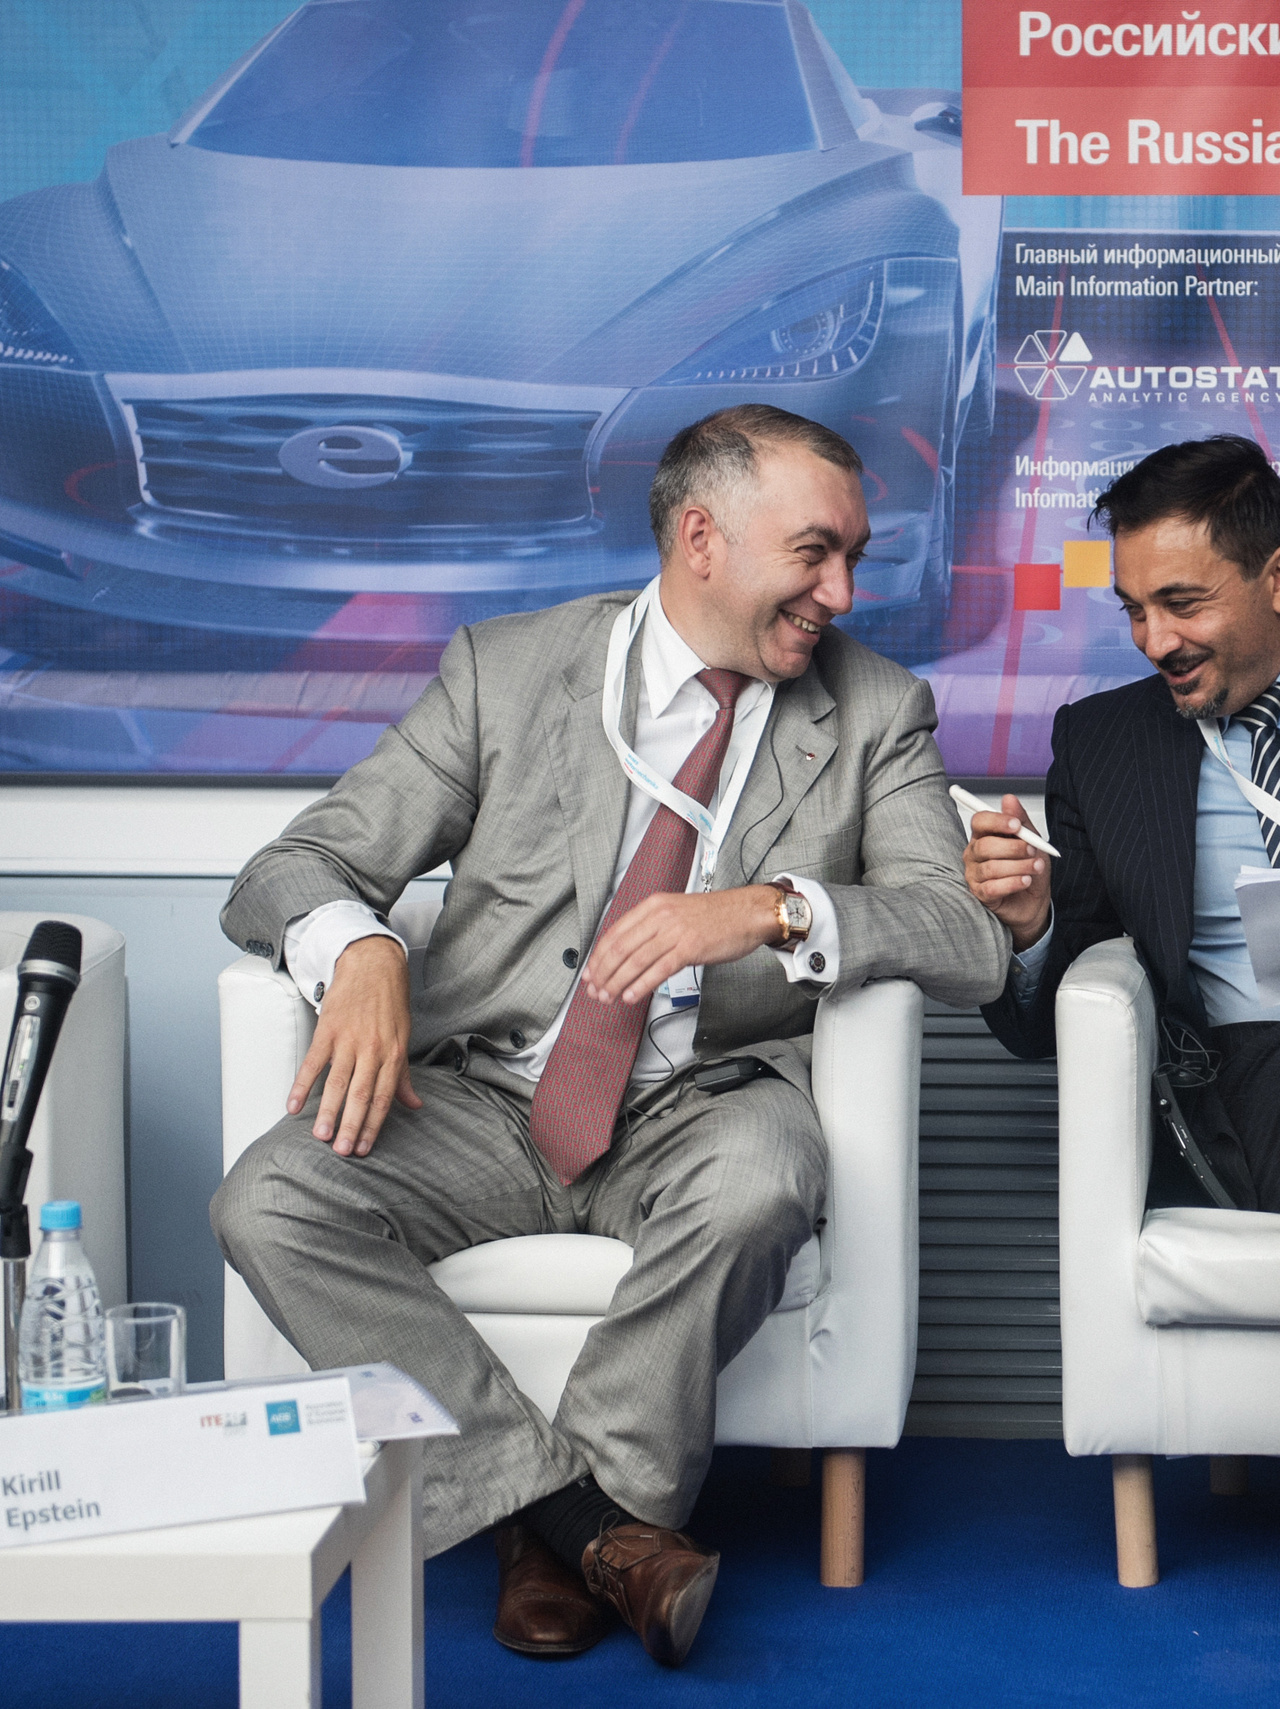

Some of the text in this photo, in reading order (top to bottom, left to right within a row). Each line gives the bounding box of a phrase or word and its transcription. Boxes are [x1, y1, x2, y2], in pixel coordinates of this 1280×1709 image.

[1015, 119, 1112, 166] The
[1015, 244, 1099, 266] Главный
[1015, 275, 1260, 297] Main Information Partner:
[1088, 392, 1189, 404] ANALYTIC
[2, 1470, 61, 1496] Kirill
[6, 1499, 101, 1531] Epstein
